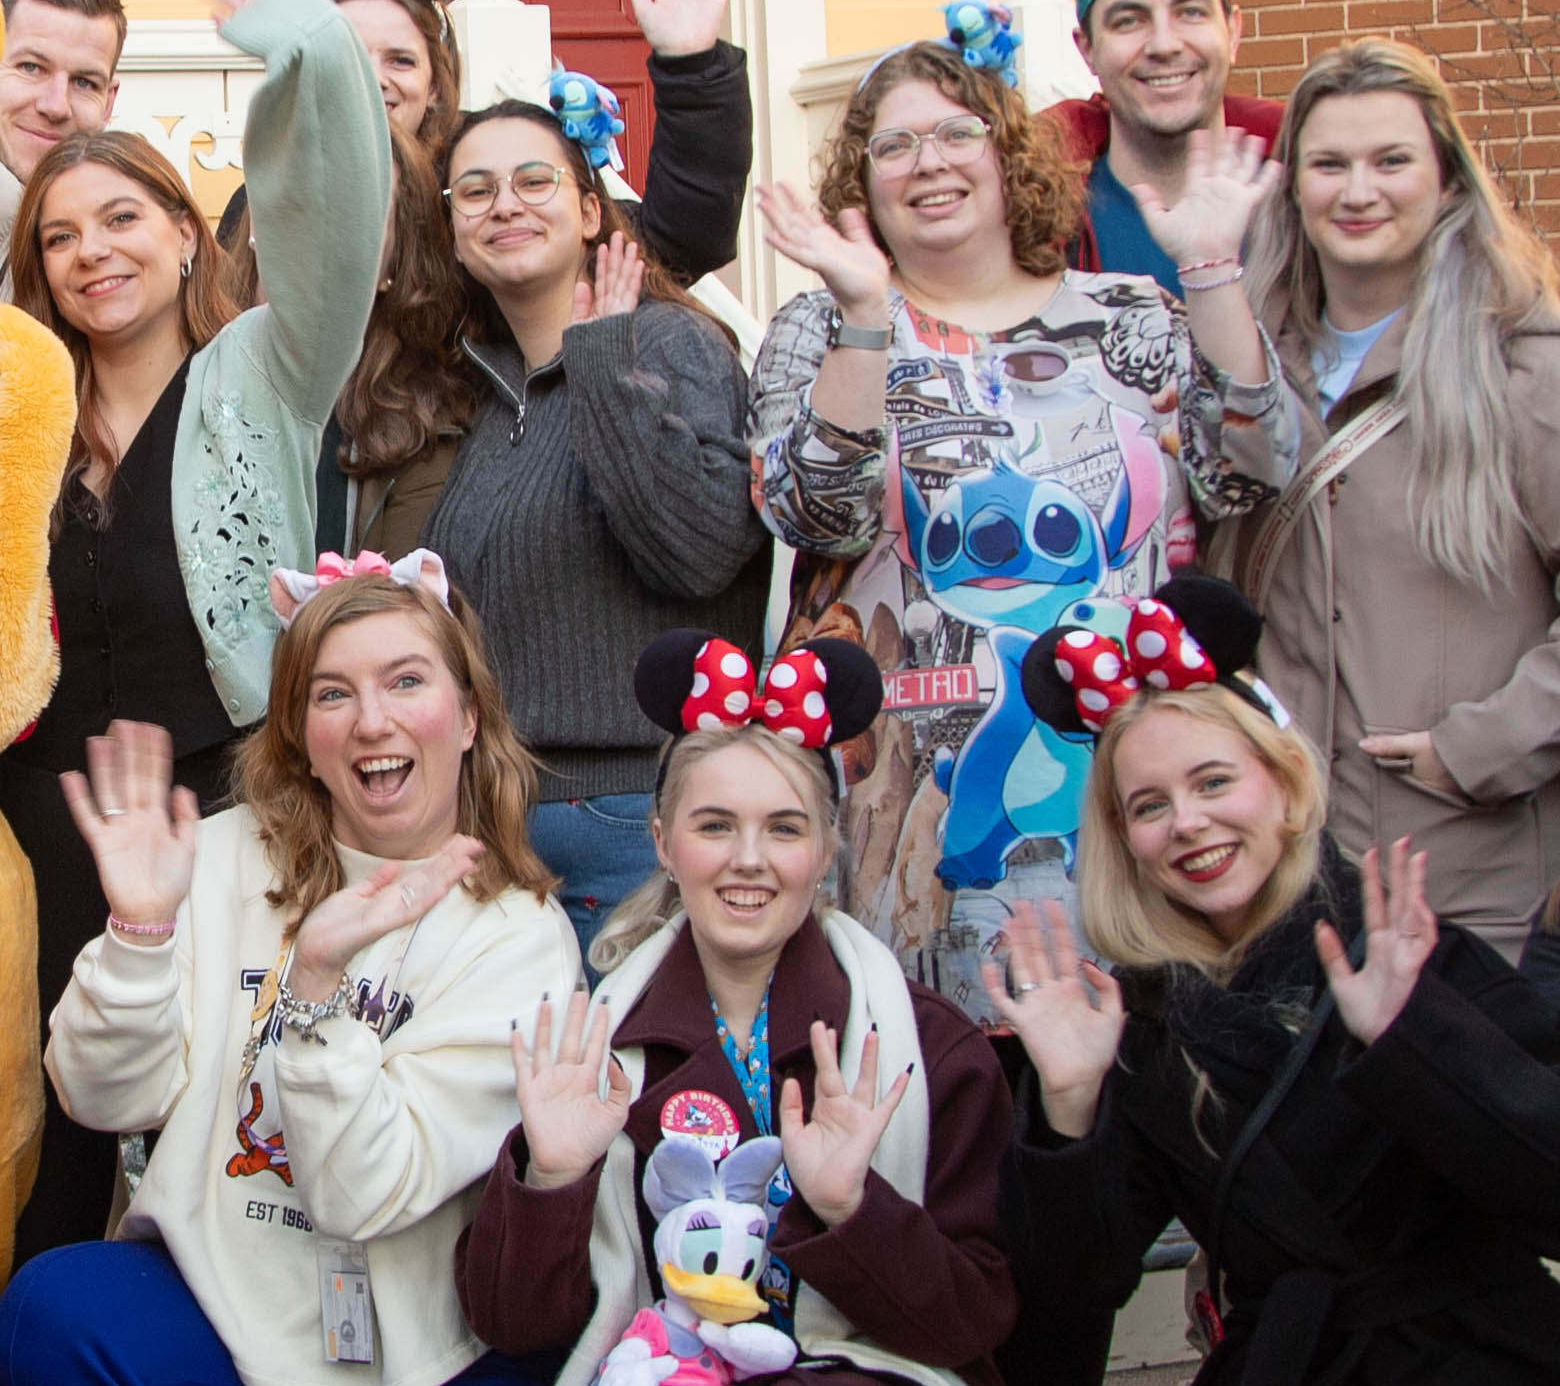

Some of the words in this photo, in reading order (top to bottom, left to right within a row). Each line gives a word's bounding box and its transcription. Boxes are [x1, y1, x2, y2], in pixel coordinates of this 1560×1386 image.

[664, 1093, 686, 1126] HAPPY
[689, 1092, 735, 1134] BIRTHDAY
[245, 1199, 279, 1224] EST
